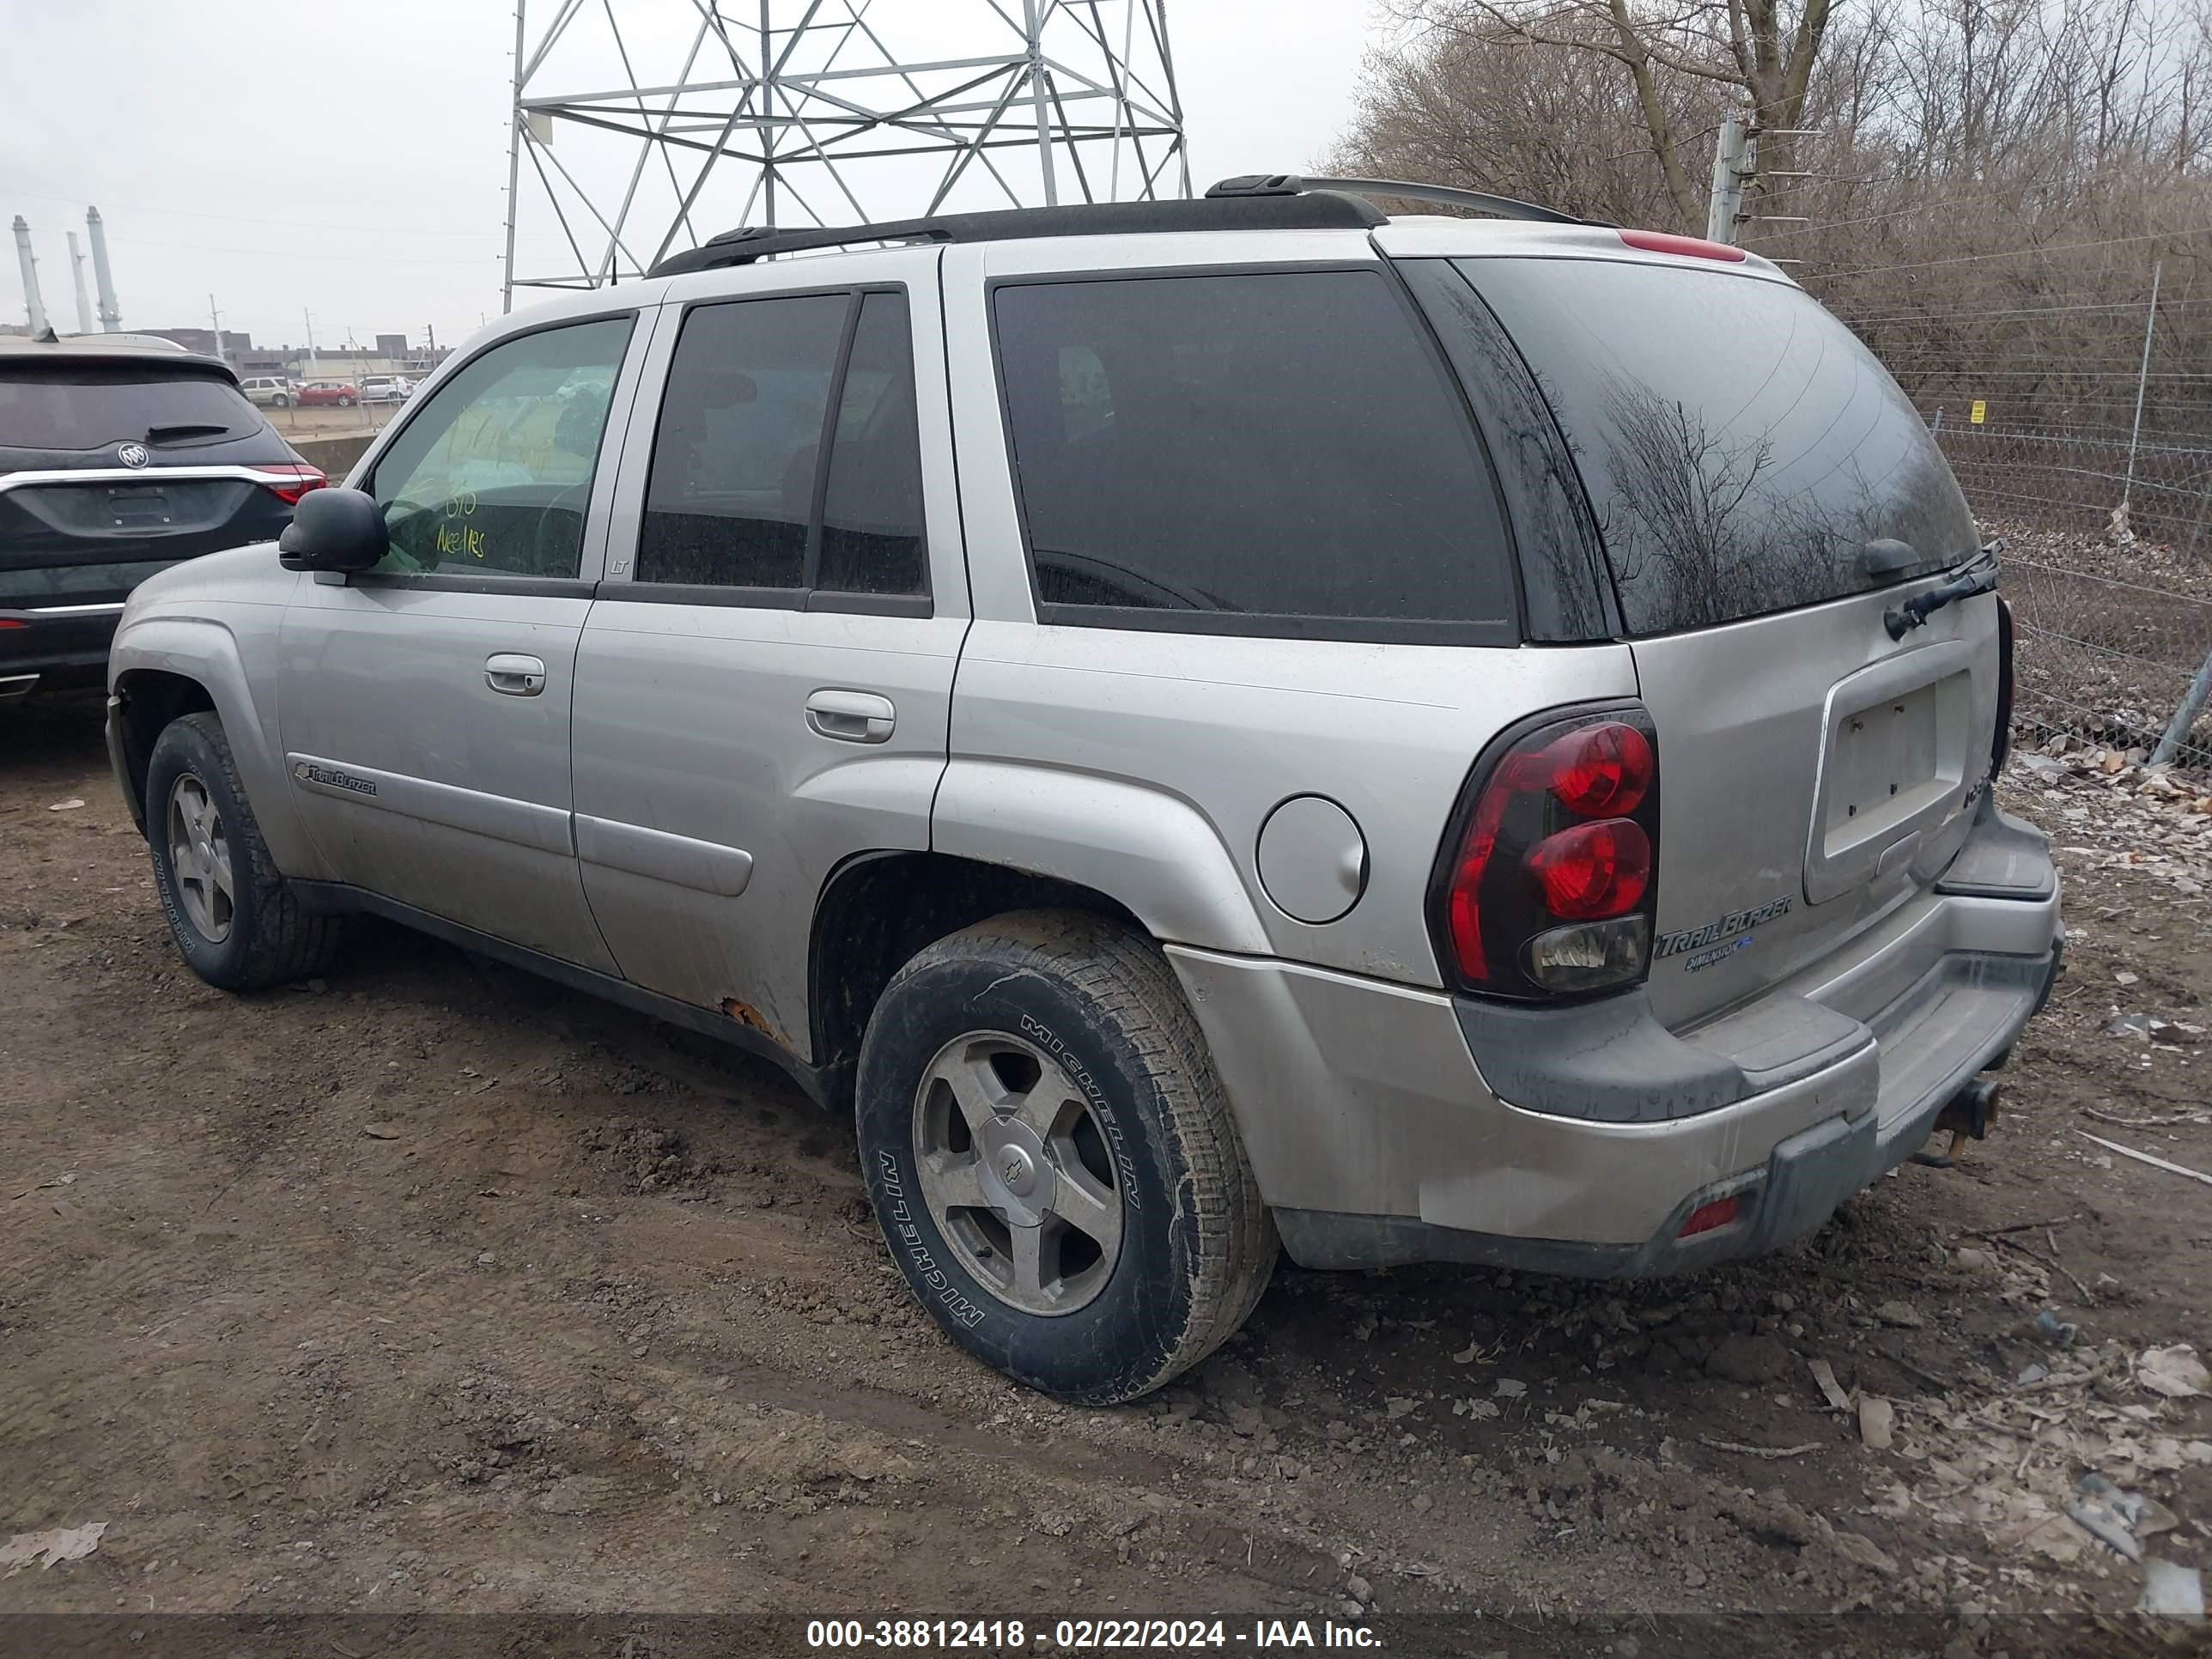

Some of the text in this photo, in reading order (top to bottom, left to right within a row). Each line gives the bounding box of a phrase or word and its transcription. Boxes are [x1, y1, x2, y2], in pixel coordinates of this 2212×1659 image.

[611, 560, 629, 574] LT
[309, 765, 377, 796] TRAILBLAZER
[1655, 893, 1793, 959] TRAILBLAZER
[1021, 1013, 1143, 1211] MICHELIN
[878, 1149, 987, 1329] MICHELIN
